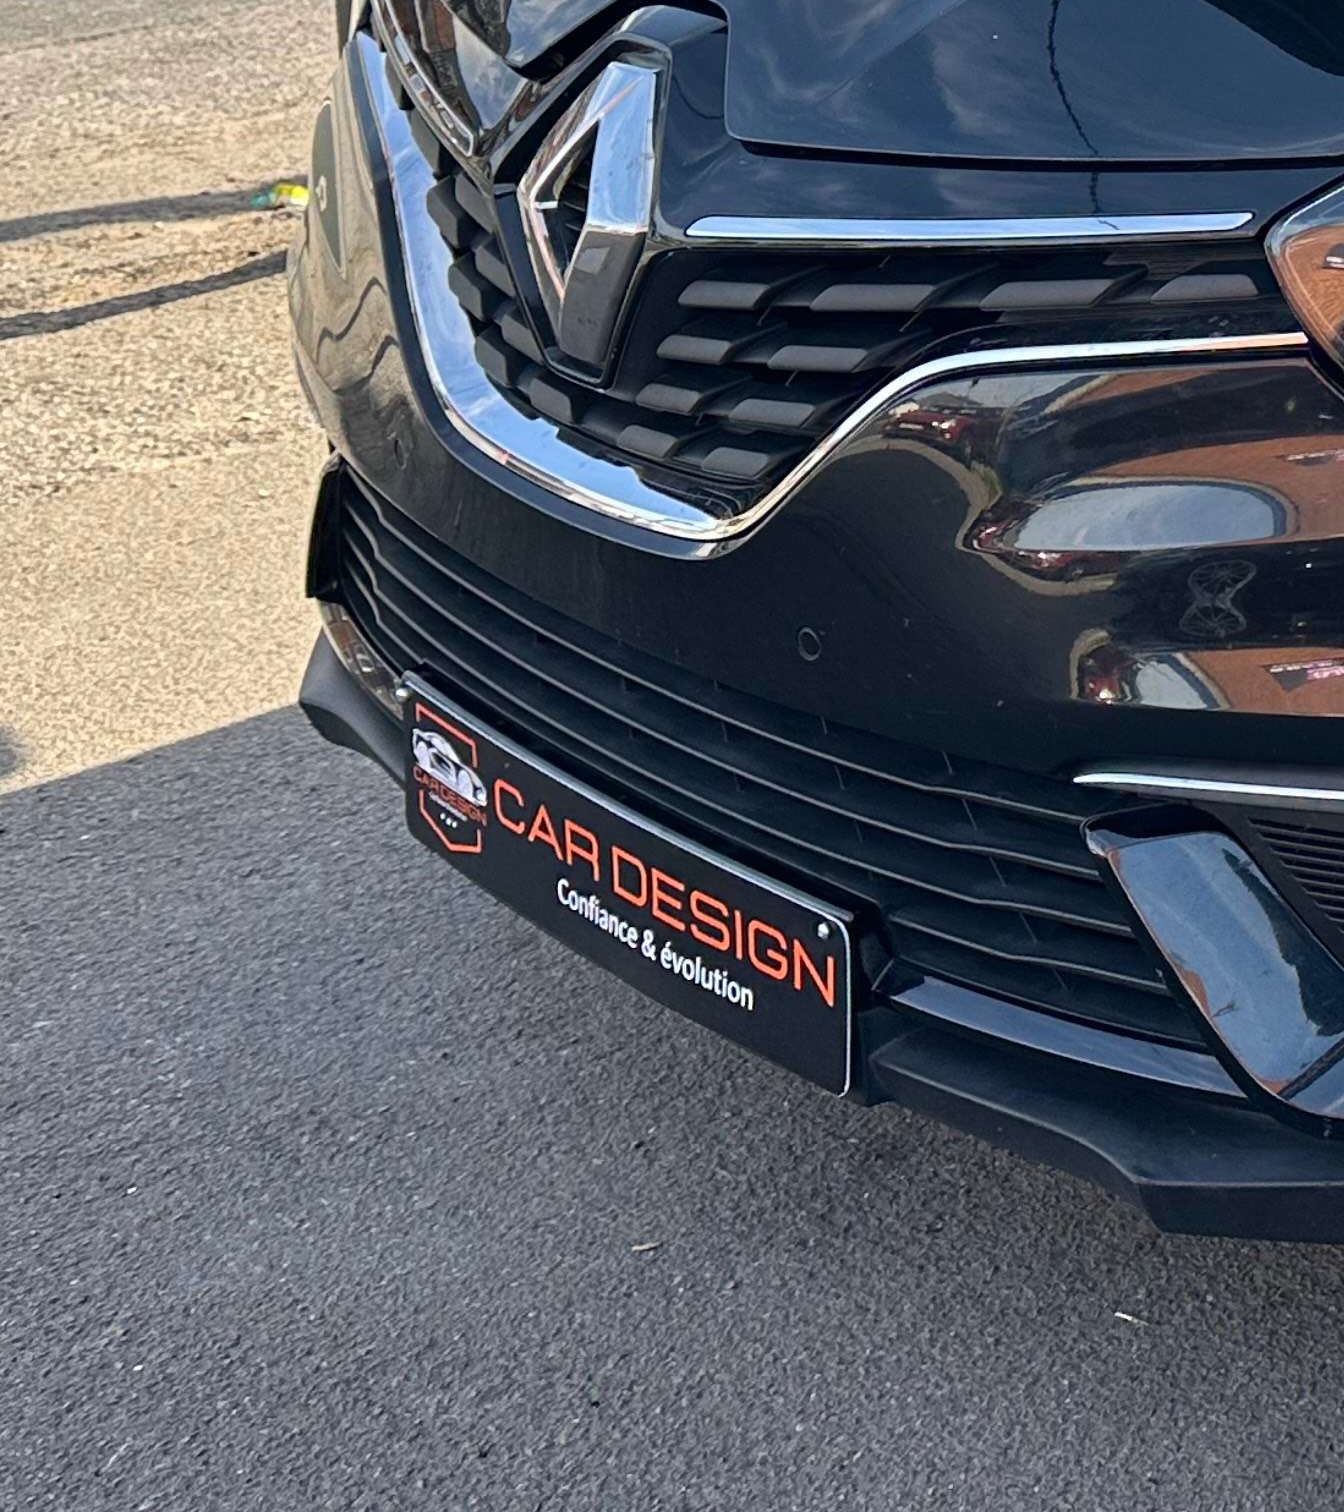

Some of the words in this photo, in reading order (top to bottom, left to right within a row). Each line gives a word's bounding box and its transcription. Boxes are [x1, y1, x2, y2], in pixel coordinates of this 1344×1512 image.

[413, 766, 440, 797] CAR
[440, 784, 488, 827] DESIGN
[494, 778, 600, 882] CAR
[612, 844, 835, 1007] DESIGN
[557, 877, 640, 950] Confiance
[641, 930, 658, 962] &
[660, 941, 755, 1011] évolution
